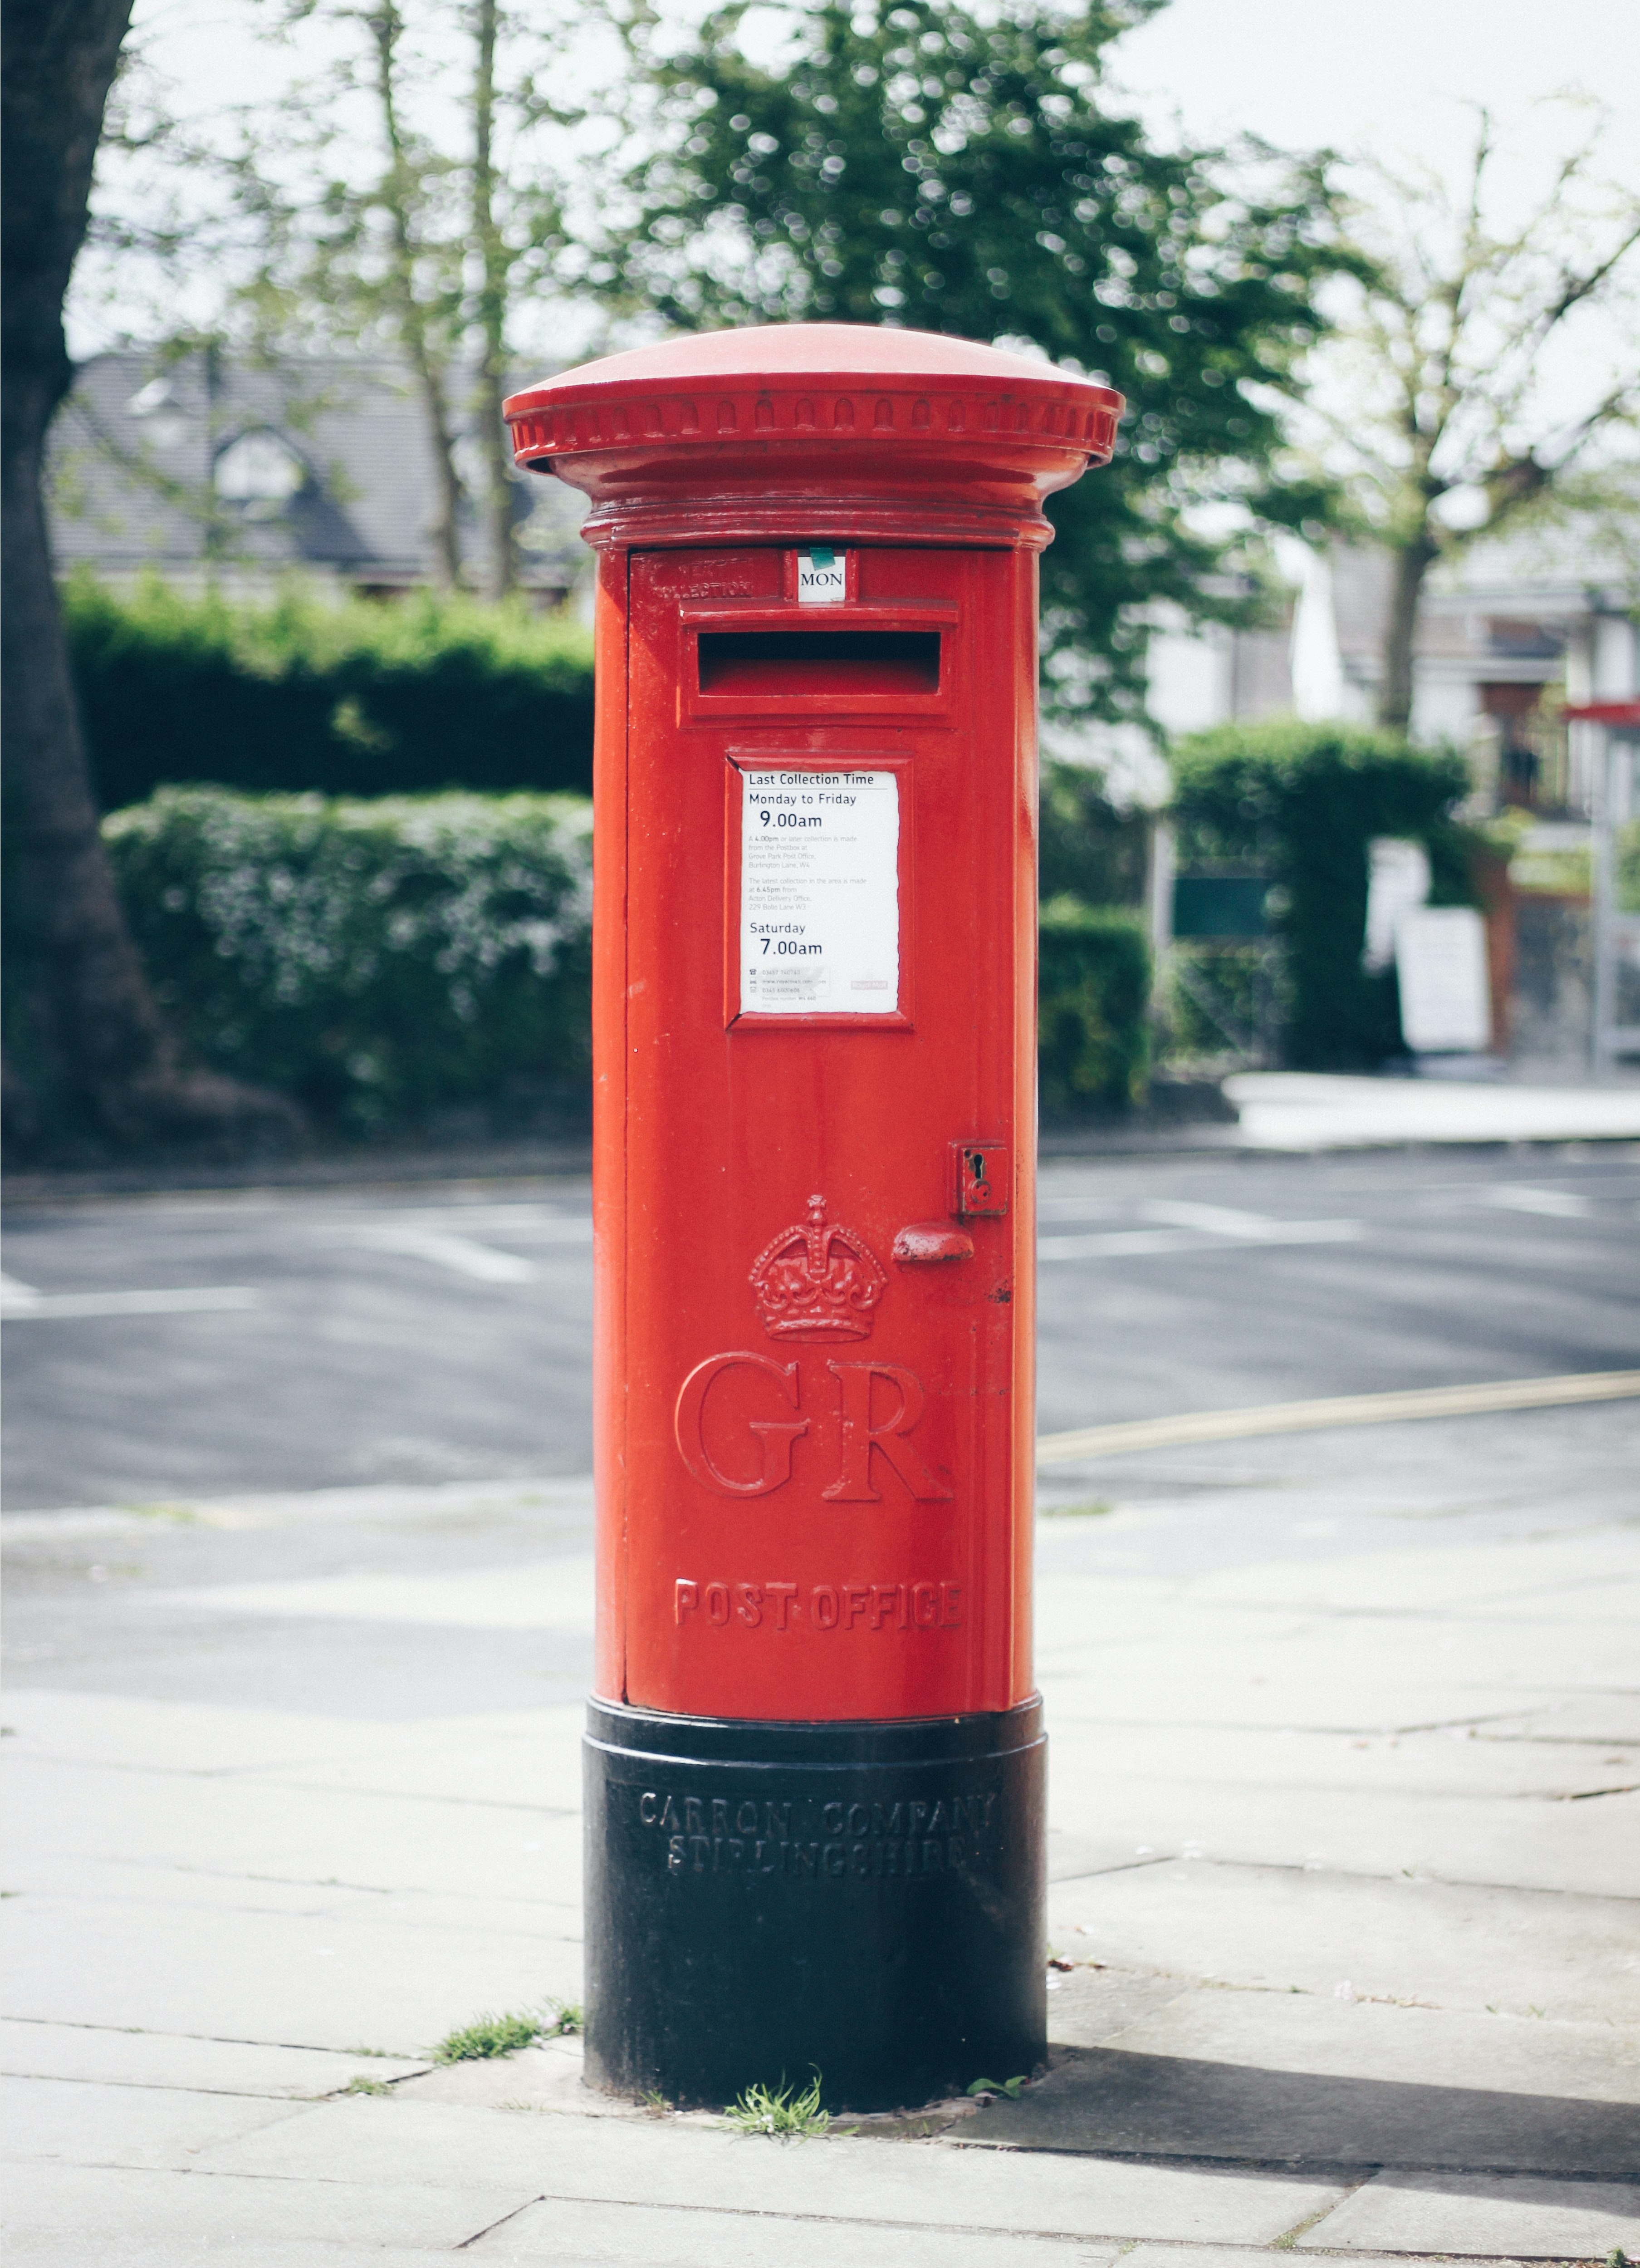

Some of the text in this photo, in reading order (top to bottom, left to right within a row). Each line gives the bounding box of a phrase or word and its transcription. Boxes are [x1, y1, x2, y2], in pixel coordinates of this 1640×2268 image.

[800, 573, 843, 586] MON
[749, 774, 874, 785] Last Collection Time
[749, 794, 857, 806] Monday to Friday
[760, 810, 822, 827] 9.00am
[750, 923, 805, 935] Saturday
[760, 939, 822, 955] 7.00am
[674, 1350, 954, 1502] GR
[674, 1578, 962, 1631] POST OFFICE
[639, 1792, 997, 1837] CARRON COMPANY
